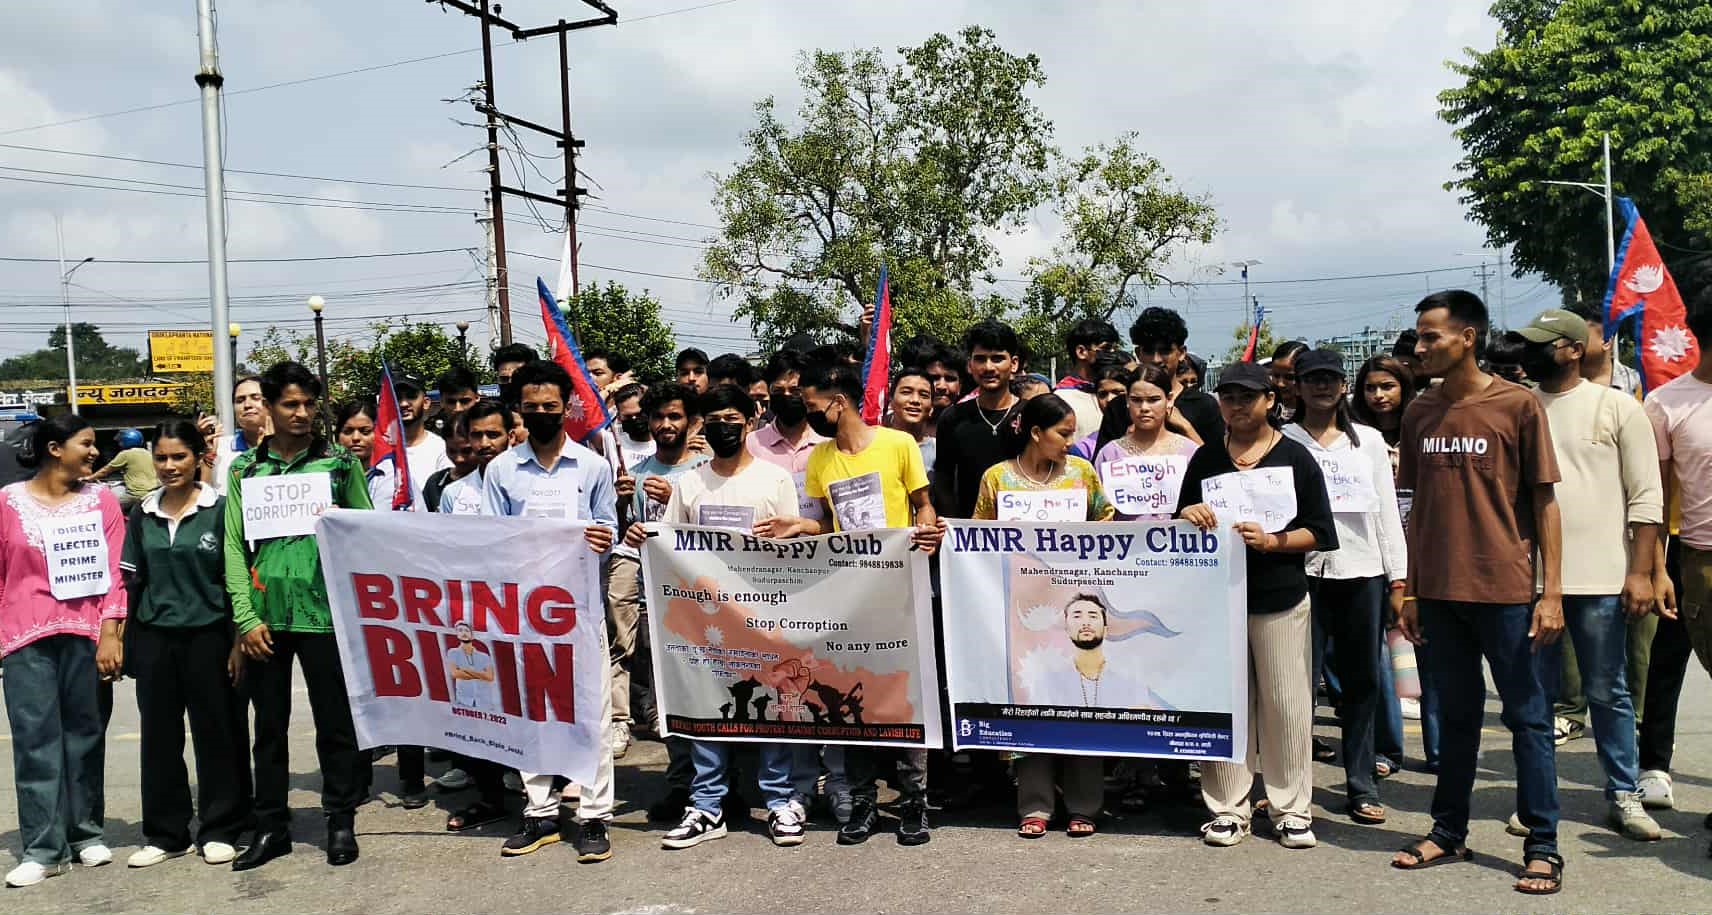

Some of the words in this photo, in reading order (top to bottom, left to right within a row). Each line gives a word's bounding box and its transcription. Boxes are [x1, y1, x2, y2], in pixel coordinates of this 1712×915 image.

[1423, 437, 1488, 454] MILANO
[1110, 460, 1176, 481] Enough
[263, 483, 312, 502] STOP
[1002, 494, 1032, 513] Say
[53, 540, 100, 552] ELECTED
[673, 529, 735, 552] MNR
[742, 534, 819, 560] Happy
[827, 533, 883, 556] Club
[954, 527, 1025, 552] MNR
[1035, 527, 1135, 560] Happy
[1146, 526, 1218, 553] Club
[60, 555, 97, 567] PRIME
[828, 558, 858, 568] Contact:
[1135, 557, 1168, 567] Contact:
[1170, 558, 1218, 567] 9848819838
[54, 571, 103, 584] MINISTER
[1020, 567, 1091, 578] Mahendranagar,
[1094, 568, 1149, 578] Kanchanpur
[1051, 577, 1115, 586] Sudurpaschim
[662, 584, 712, 602] Enough
[717, 590, 729, 602] is
[734, 590, 788, 606] enough
[351, 572, 577, 637] BRING
[746, 617, 775, 631] Stop
[779, 618, 848, 632] Corroption
[826, 641, 843, 652] No
[847, 642, 871, 656] any
[876, 639, 909, 651] more
[717, 723, 738, 733] CALLS
[879, 728, 904, 738] LAVISH
[905, 729, 921, 738] LIFE
[978, 728, 1013, 737] Education
